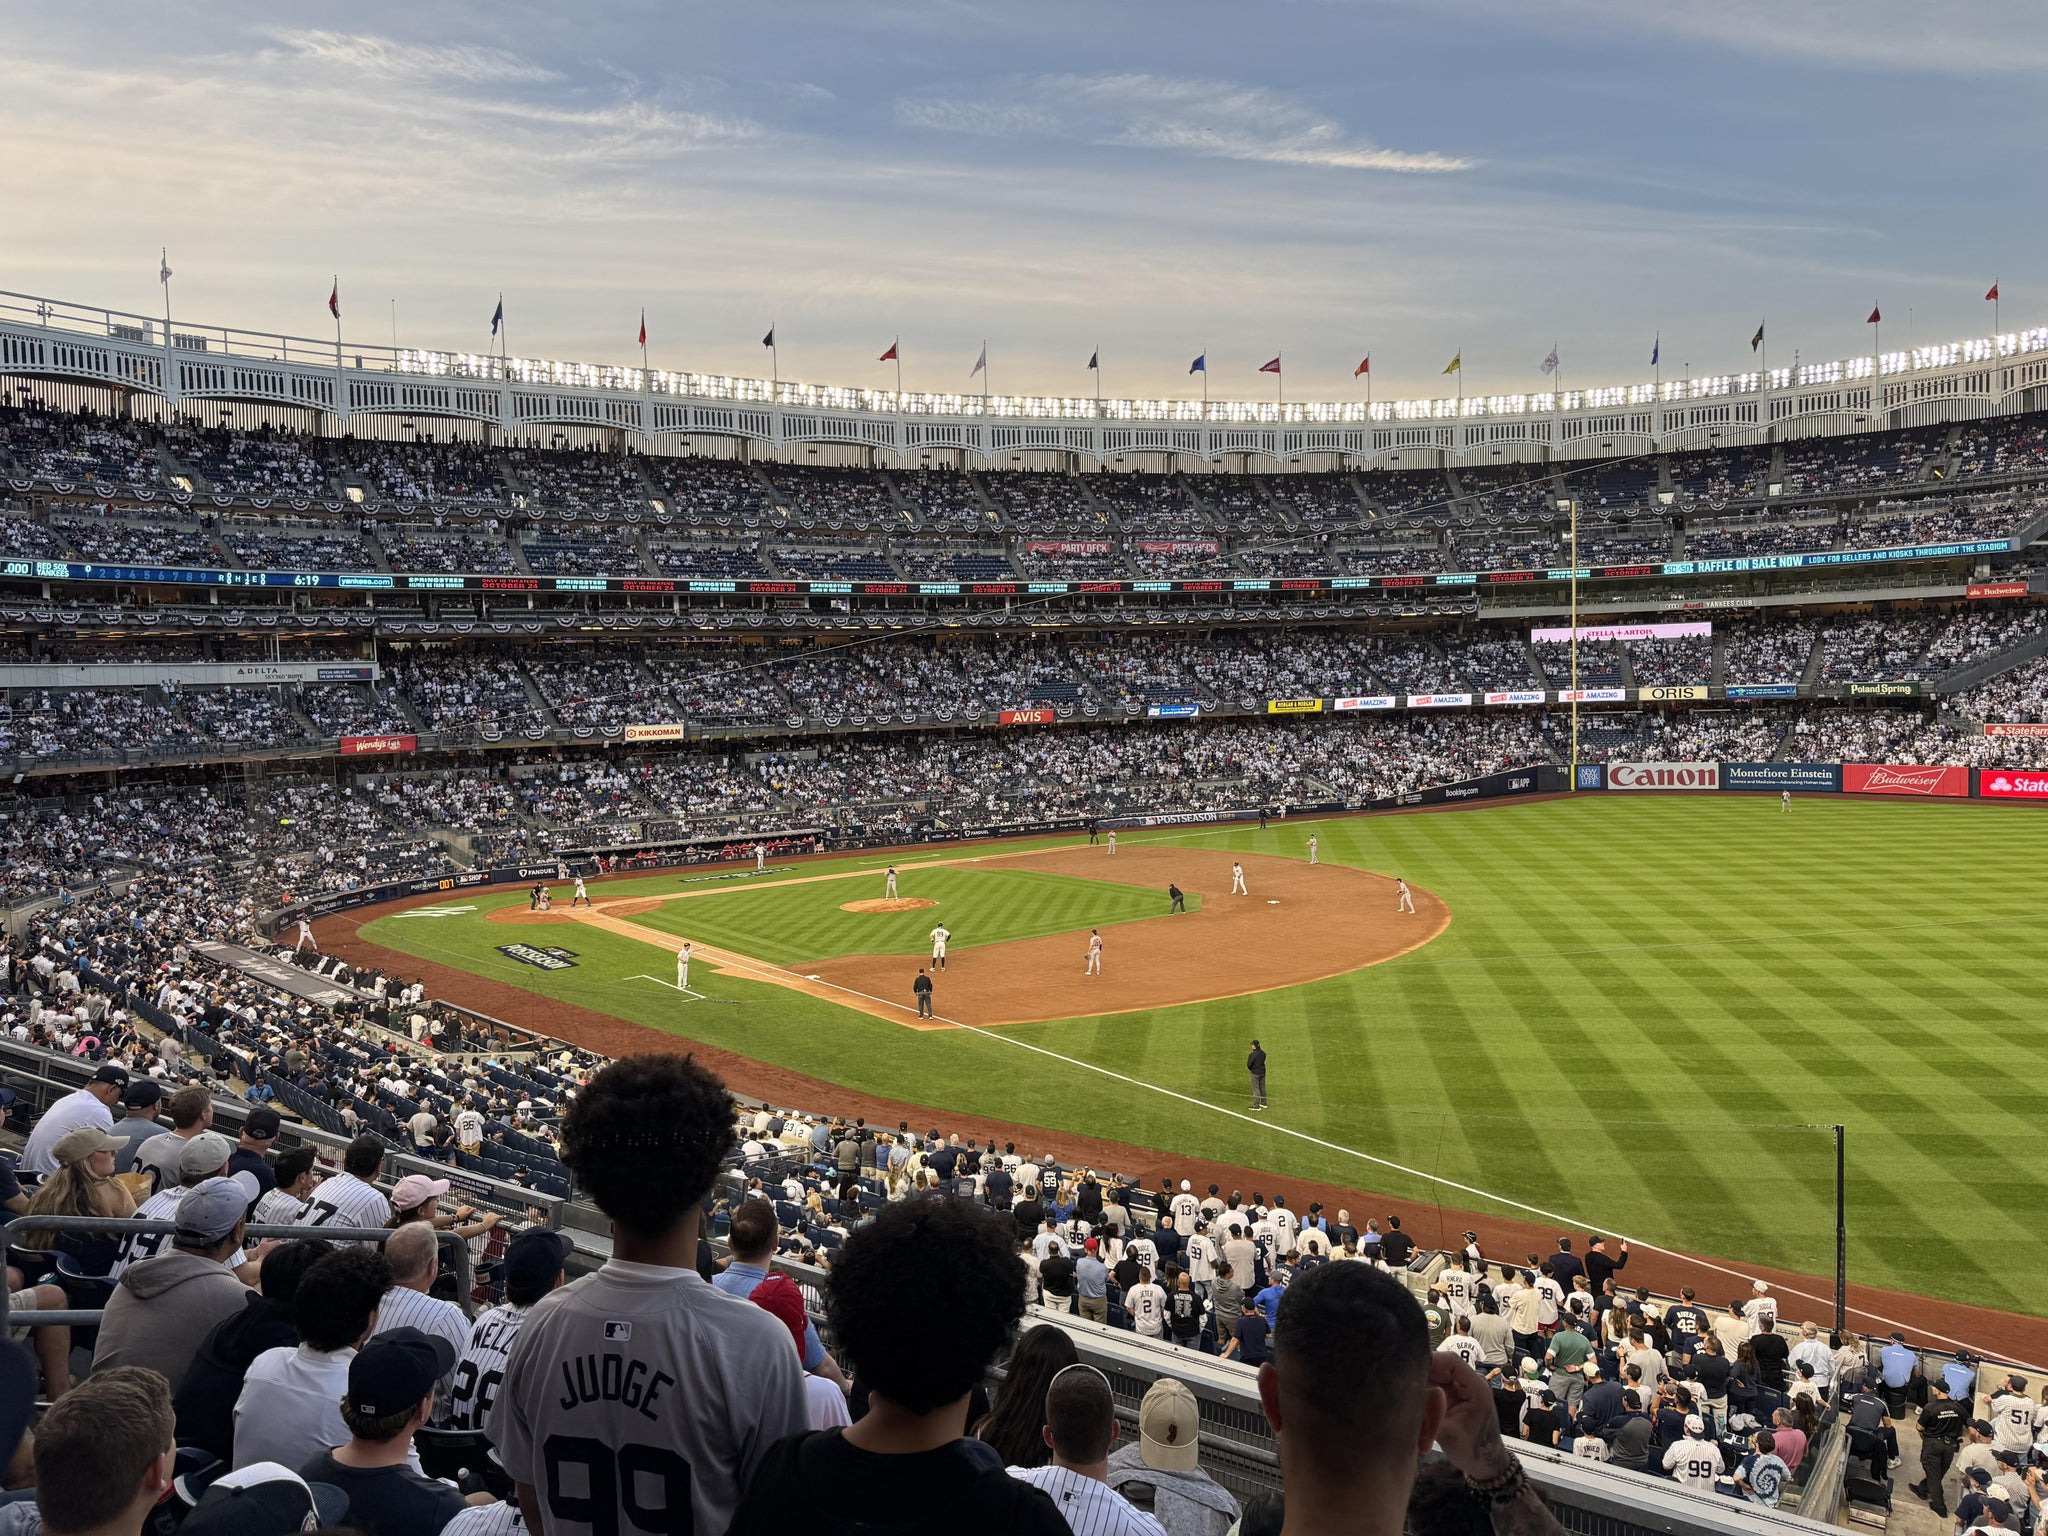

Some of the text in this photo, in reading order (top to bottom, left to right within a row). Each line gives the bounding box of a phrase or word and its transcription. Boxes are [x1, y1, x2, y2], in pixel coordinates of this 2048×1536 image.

[1062, 544, 1085, 552] PARTY
[1086, 544, 1107, 552] DECK
[1809, 542, 2008, 564] LOOK FOR SELLERS AND KIOSKS THROUGHOUT THE STADIUM
[4, 563, 28, 574] .000
[1698, 556, 1803, 572] RAFFLE ON SALE NOW
[37, 569, 70, 578] YANKEES
[100, 570, 206, 582] 2 3 4 5 6 7 8 9
[294, 575, 320, 586] 6:19
[341, 578, 390, 586] yankees.com
[1984, 586, 2024, 596] Budweiser
[1706, 600, 1734, 608] YANKEES
[1652, 688, 1694, 699] ORIS
[1851, 684, 1912, 694] Poland Spring
[1013, 711, 1041, 722] AVIS
[2006, 727, 2030, 736] State
[356, 739, 387, 752] Wendy's
[1609, 766, 1716, 786] Canon
[1730, 768, 1833, 779] Montefiore Einstein
[1870, 772, 1937, 785] Budweiser
[1520, 778, 1530, 788] APP
[2014, 779, 2048, 792] State
[1446, 787, 1478, 796] Booking.com
[1156, 813, 1217, 824] POSTSEASON
[410, 882, 438, 890] POSTSEASON
[439, 879, 454, 890] 007
[462, 1120, 474, 1130] 26
[784, 1123, 795, 1131] 23
[798, 1130, 804, 1138] 2
[1004, 1164, 1017, 1173] 26
[1044, 1177, 1056, 1187] 99
[1181, 1205, 1192, 1216] 13
[1279, 1216, 1286, 1227] 2
[1259, 1234, 1273, 1245] 99
[1448, 1284, 1464, 1297] 42
[1143, 1300, 1152, 1313] 2
[1677, 1319, 1697, 1333] 42
[471, 1323, 518, 1356] WELL
[1456, 1343, 1475, 1351] BERRA
[560, 1354, 675, 1422] JUDGE
[2011, 1410, 2030, 1424] 51
[1583, 1445, 1600, 1453] FRIED
[1688, 1460, 1712, 1478] 99
[544, 1434, 694, 1536] 99
